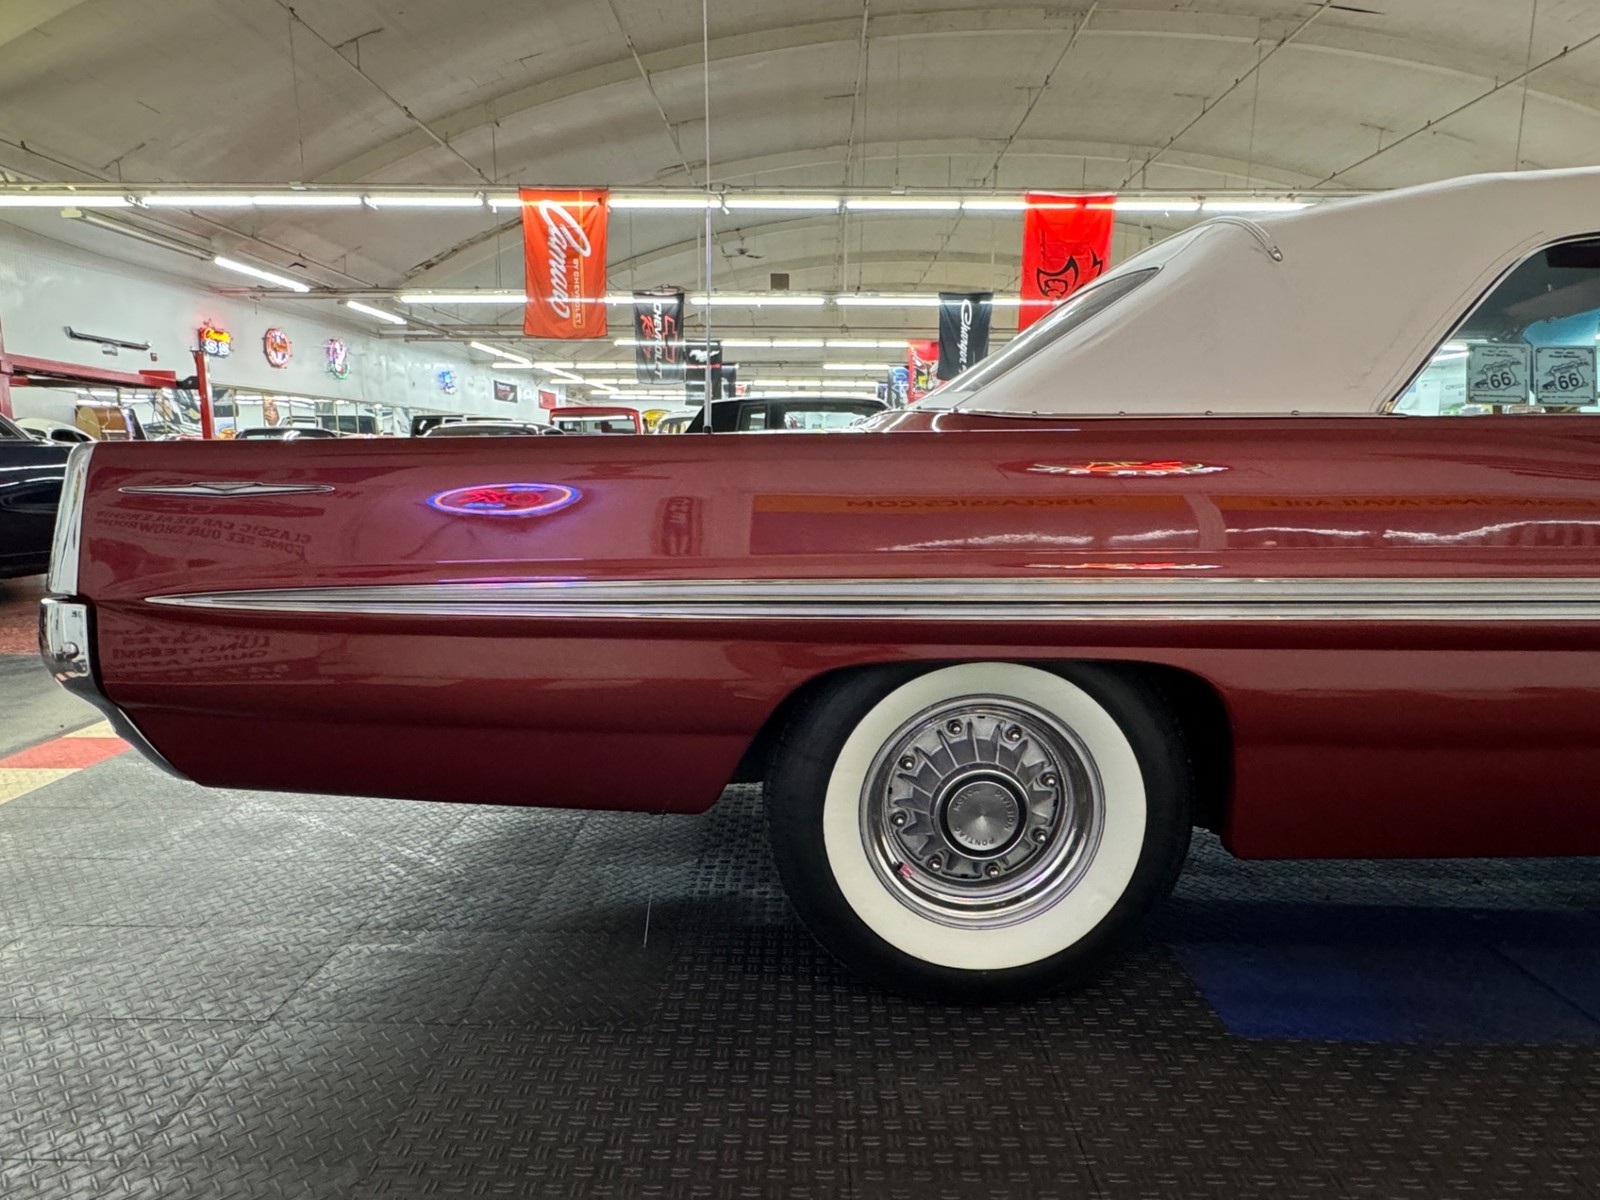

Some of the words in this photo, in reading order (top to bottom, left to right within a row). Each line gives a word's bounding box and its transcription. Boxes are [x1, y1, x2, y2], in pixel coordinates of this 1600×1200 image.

[539, 199, 592, 319] Camaro
[573, 258, 580, 269] BY
[573, 271, 582, 325] CHEVROLET
[653, 302, 663, 379] CHEVROLET
[957, 299, 973, 364] Charger
[205, 340, 230, 356] SS
[1490, 371, 1512, 389] 66
[1558, 372, 1580, 390] 66
[954, 827, 996, 846] PONTIAC
